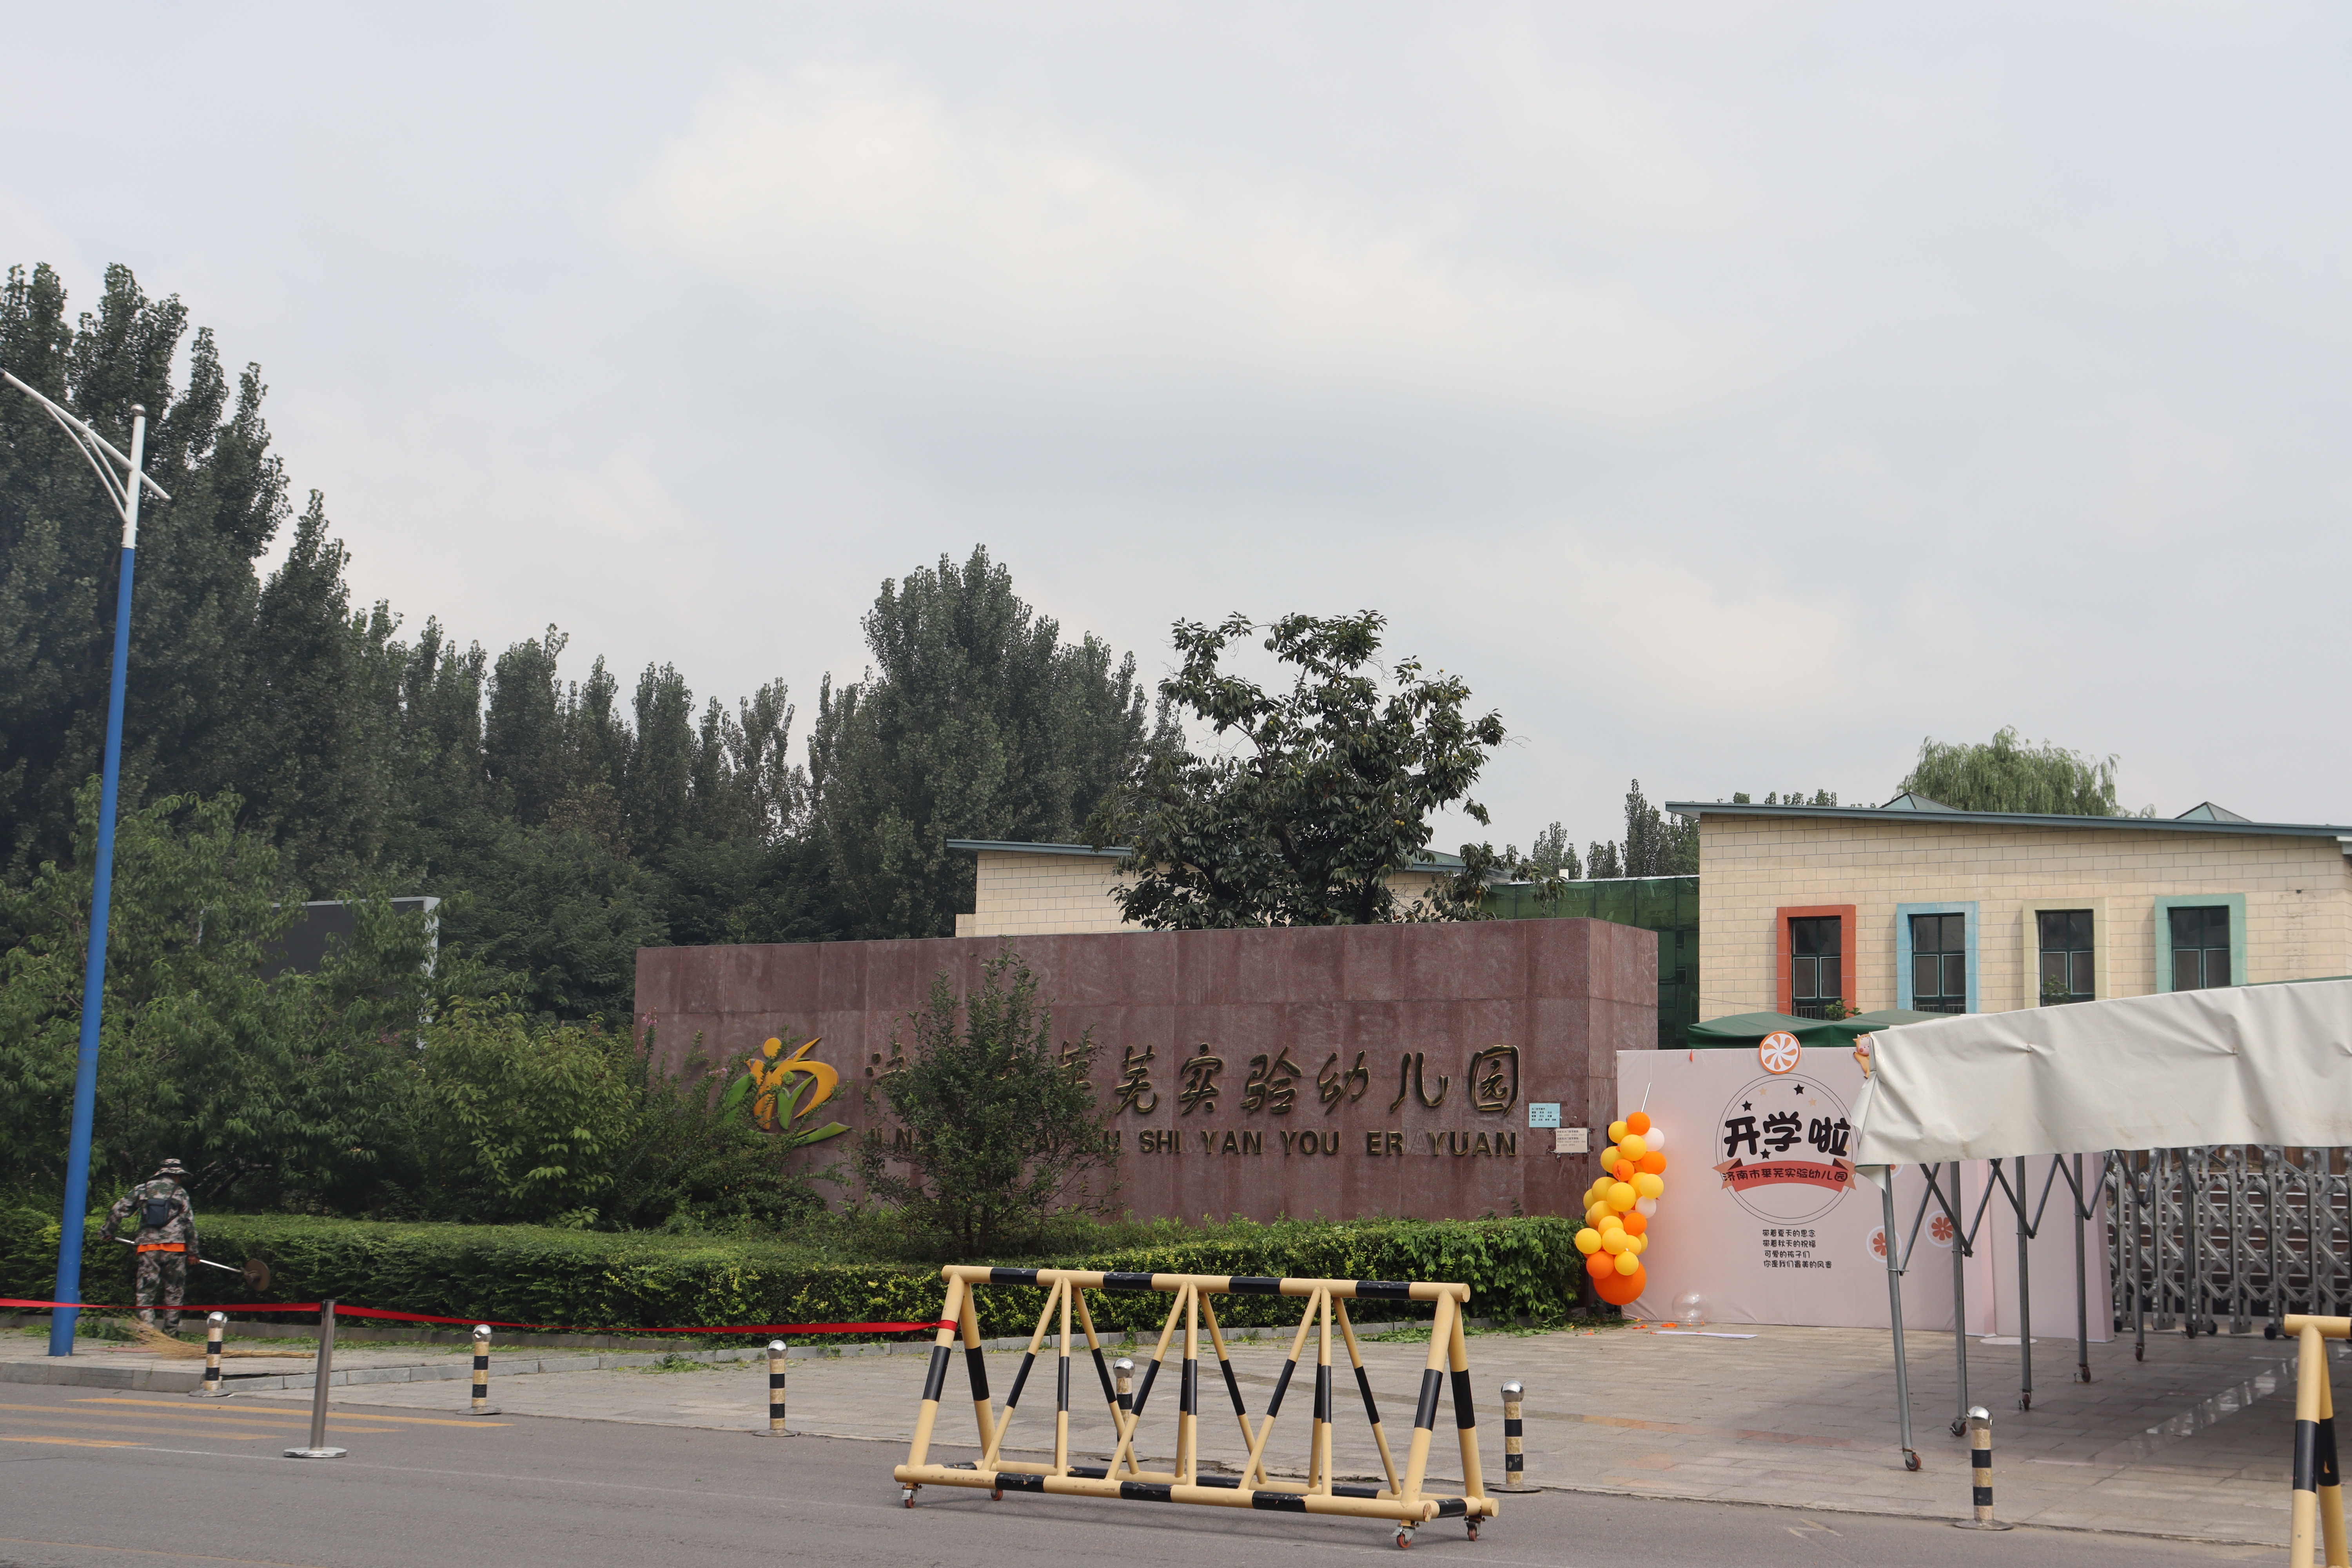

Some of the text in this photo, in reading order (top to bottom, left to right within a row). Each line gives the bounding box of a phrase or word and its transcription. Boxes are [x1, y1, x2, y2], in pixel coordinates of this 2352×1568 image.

[865, 1040, 1521, 1116] 莱芜实验幼儿园
[1724, 1111, 1851, 1158] 开学啦
[1139, 1129, 1181, 1153] SHI
[1200, 1129, 1263, 1155] YAN
[1280, 1130, 1340, 1155] YOU
[1366, 1131, 1403, 1156] ER
[1427, 1131, 1517, 1157] YUAN
[1722, 1168, 1848, 1182] 济南市莱芜实验幼儿园
[1762, 1229, 1816, 1237] 带着夏天的思念
[1762, 1240, 1816, 1248] 带着秋天的祝福
[1764, 1250, 1810, 1258] 可爱的孩子们
[1764, 1260, 1832, 1269] 你是我们最美的风景
